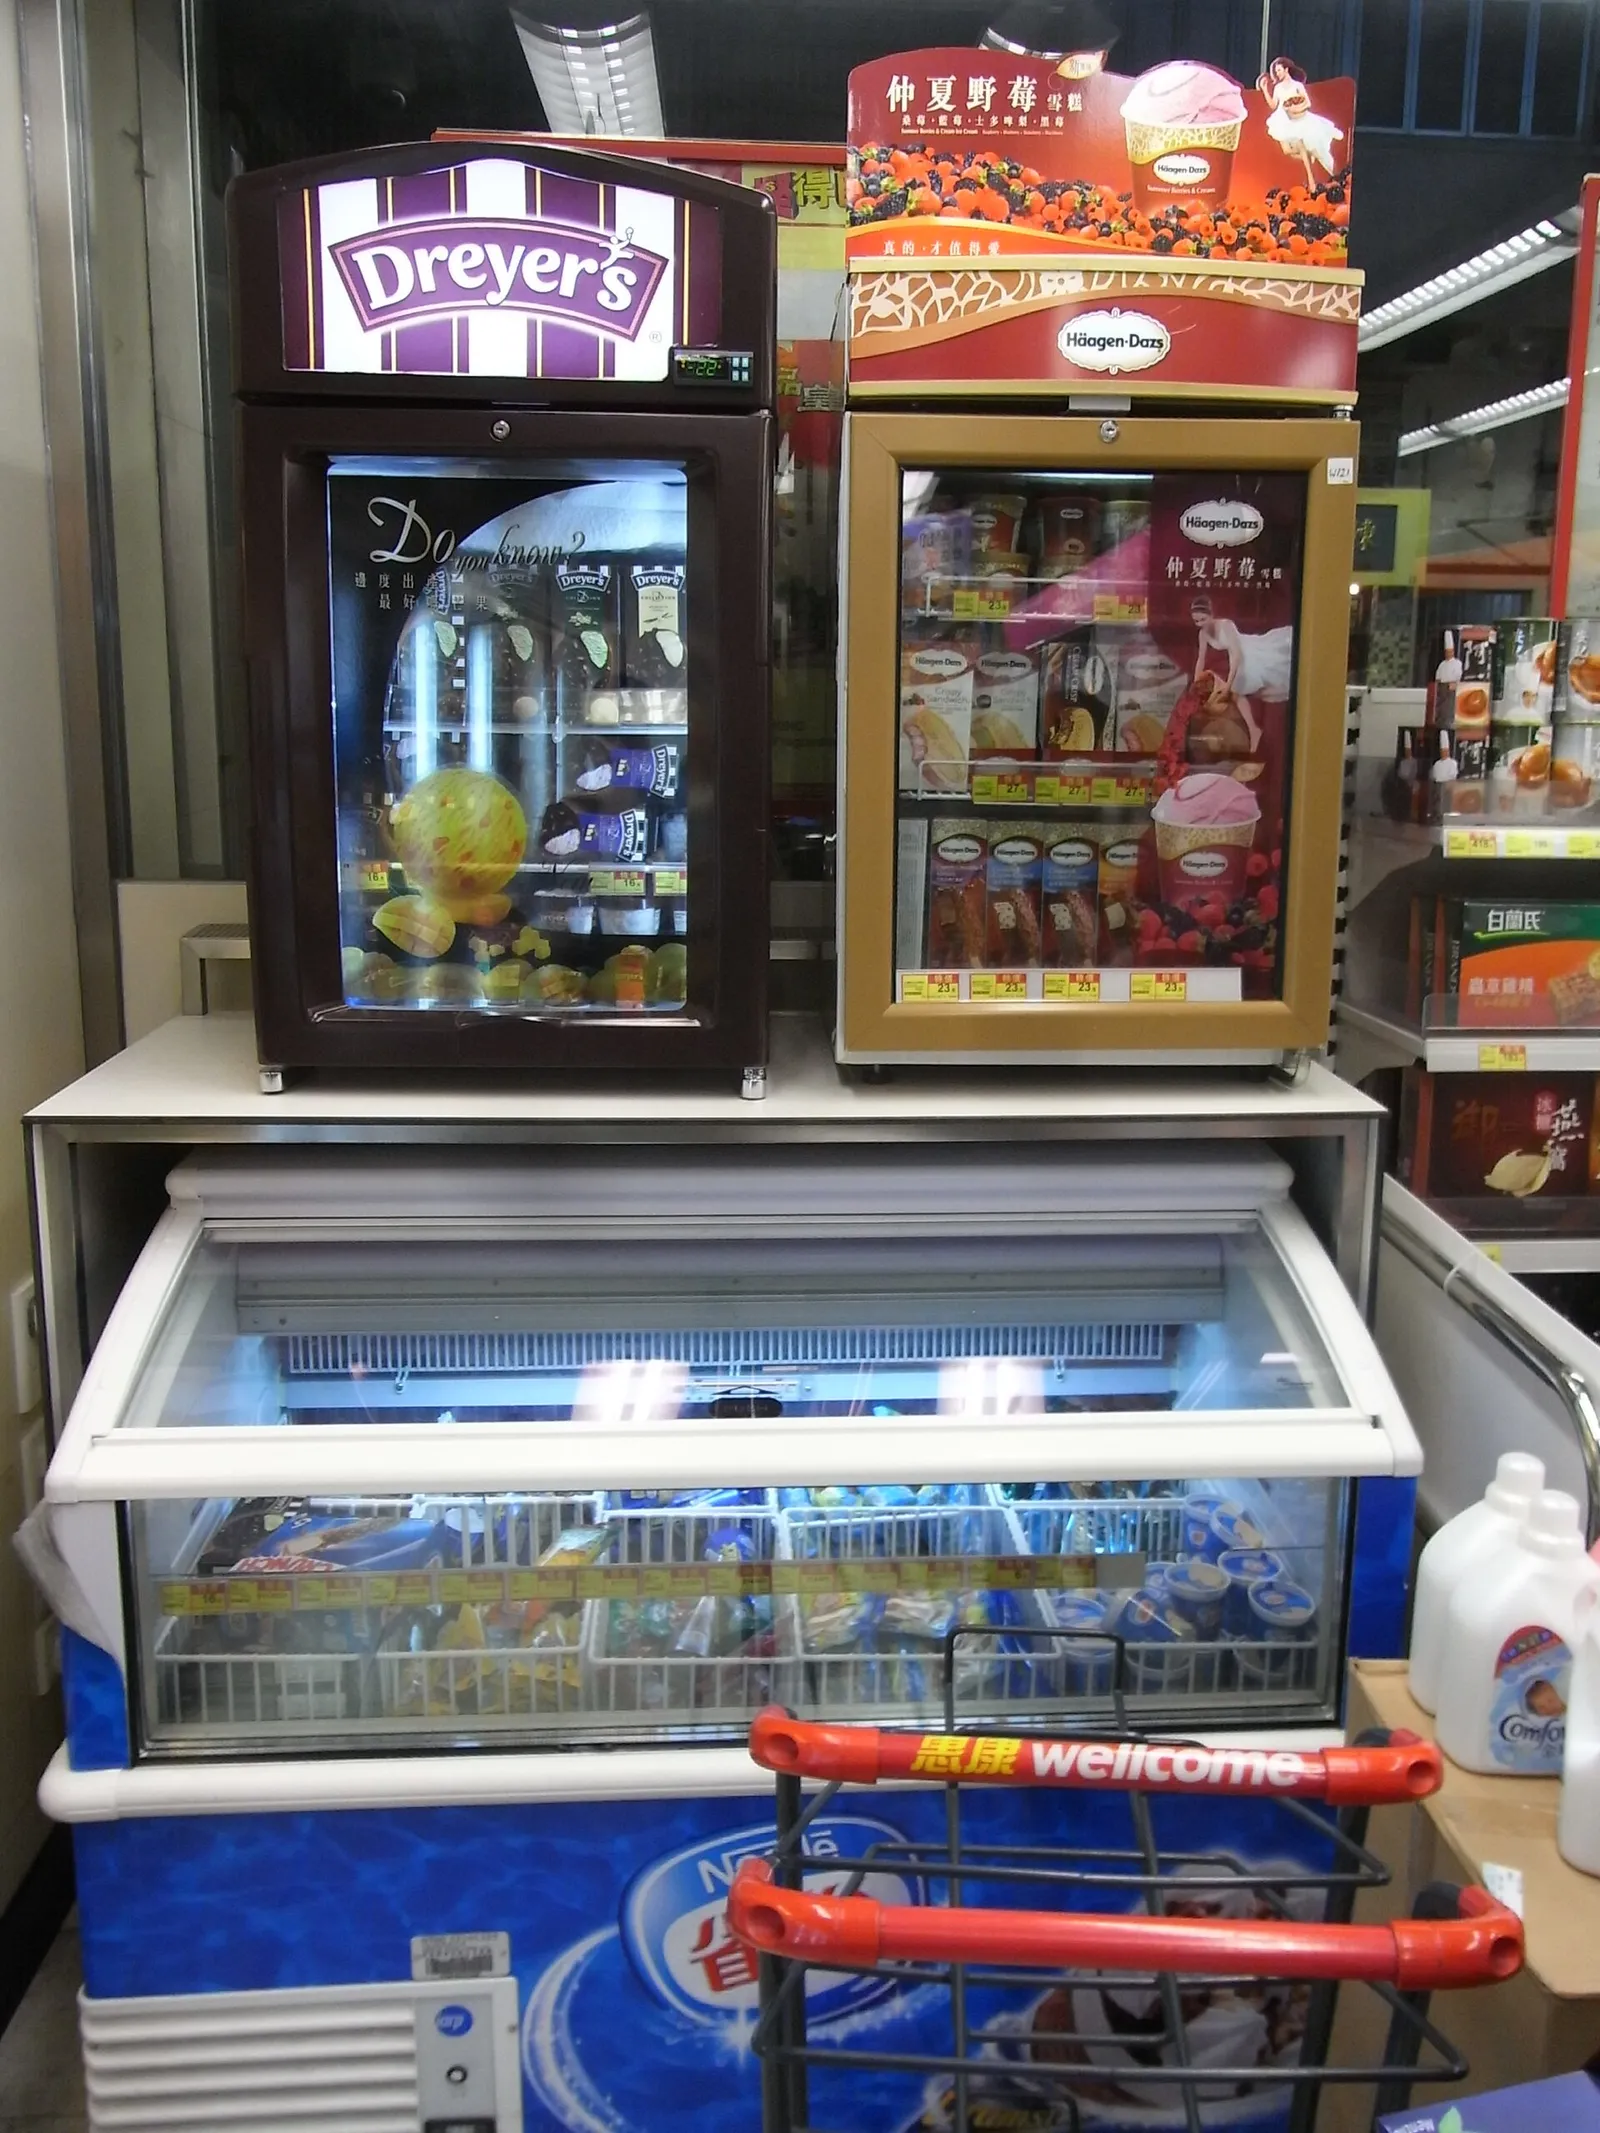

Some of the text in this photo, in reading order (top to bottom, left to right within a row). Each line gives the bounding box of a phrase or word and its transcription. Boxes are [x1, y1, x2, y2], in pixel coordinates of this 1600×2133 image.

[886, 75, 1038, 113] 仲夏野莓
[351, 232, 639, 312] Dreyer's
[1066, 330, 1164, 354] Häagen-Dazs
[367, 497, 456, 563] Do
[1185, 516, 1260, 533] Häagen-Dazs
[1165, 556, 1256, 579] 仲夏野莓
[1487, 909, 1541, 932] 白蘭氏
[911, 1734, 1303, 1788] 惠康 wellcome
